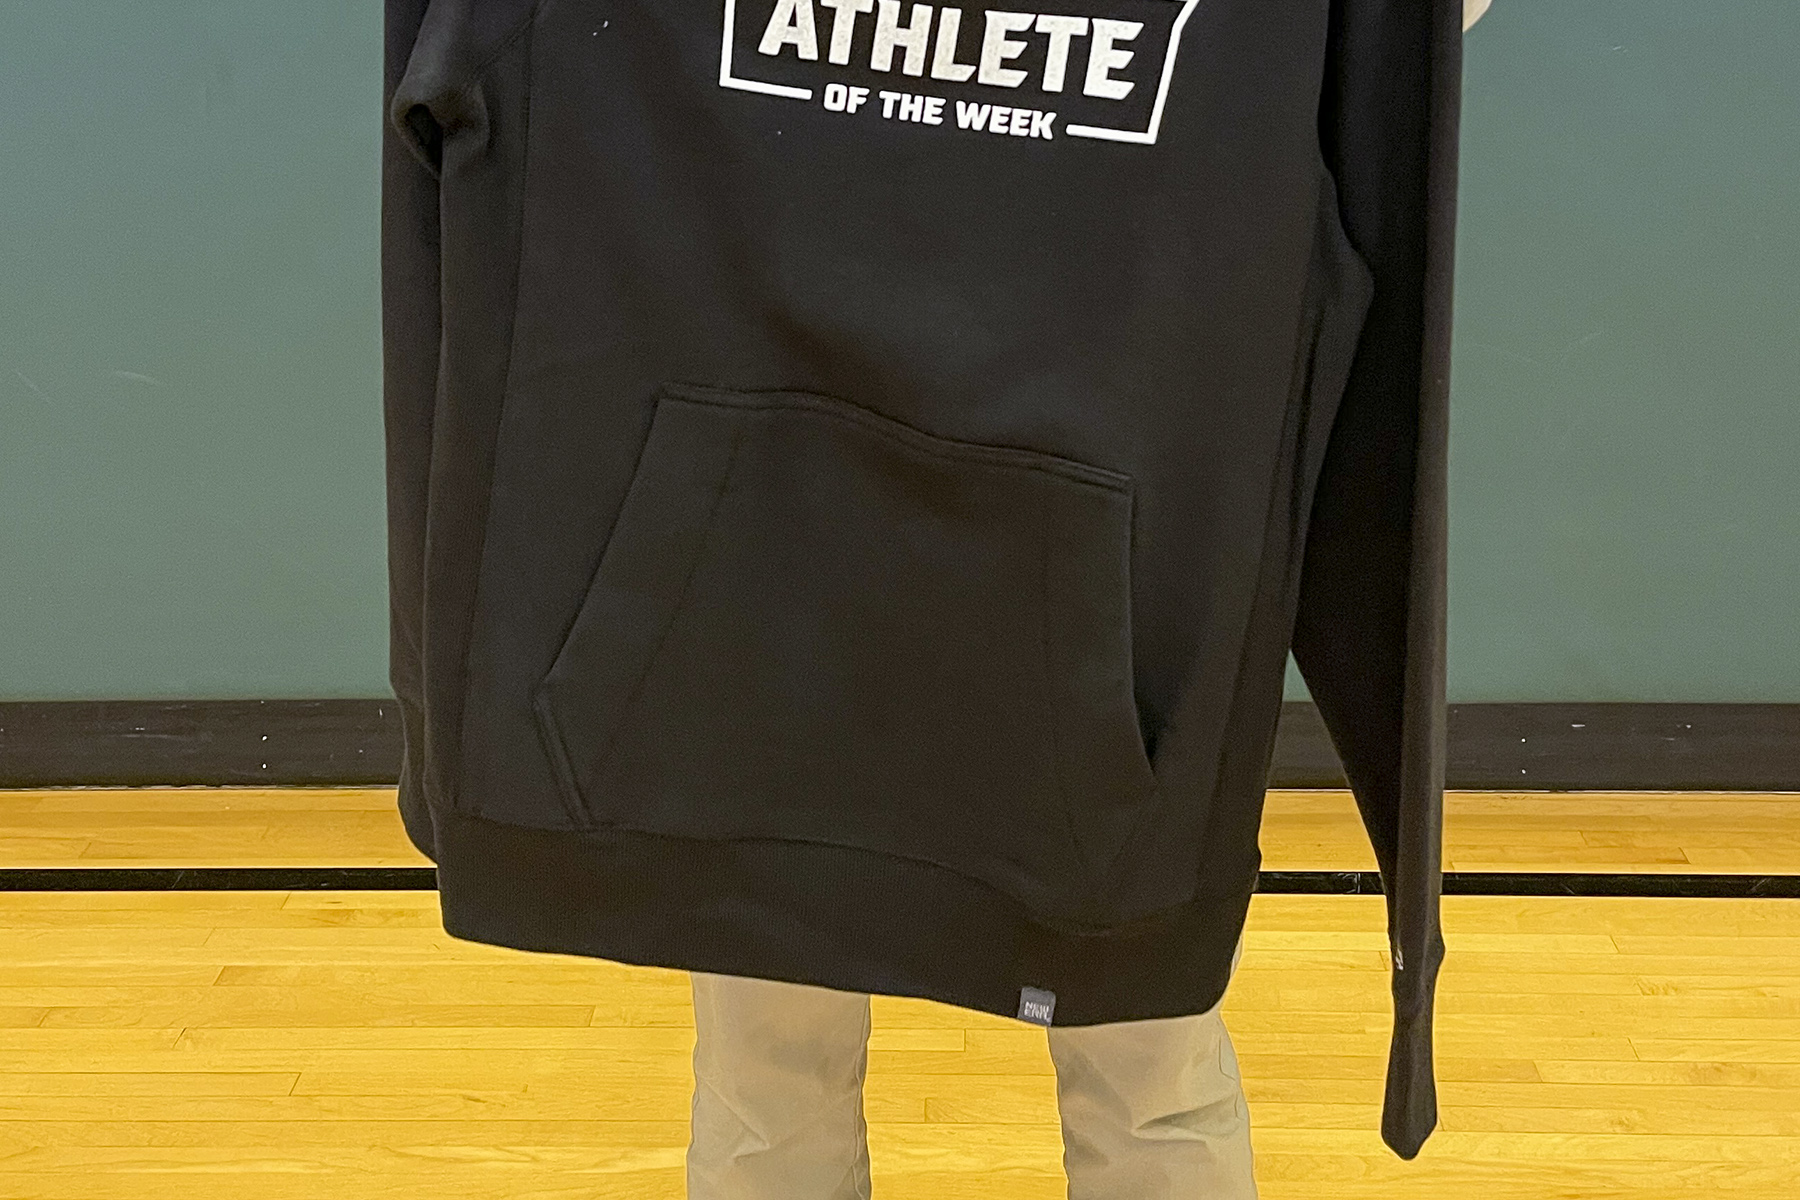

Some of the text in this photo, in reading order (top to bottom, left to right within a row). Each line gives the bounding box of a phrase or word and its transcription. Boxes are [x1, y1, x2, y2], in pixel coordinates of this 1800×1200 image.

[824, 84, 1057, 140] OF THE WEEK
